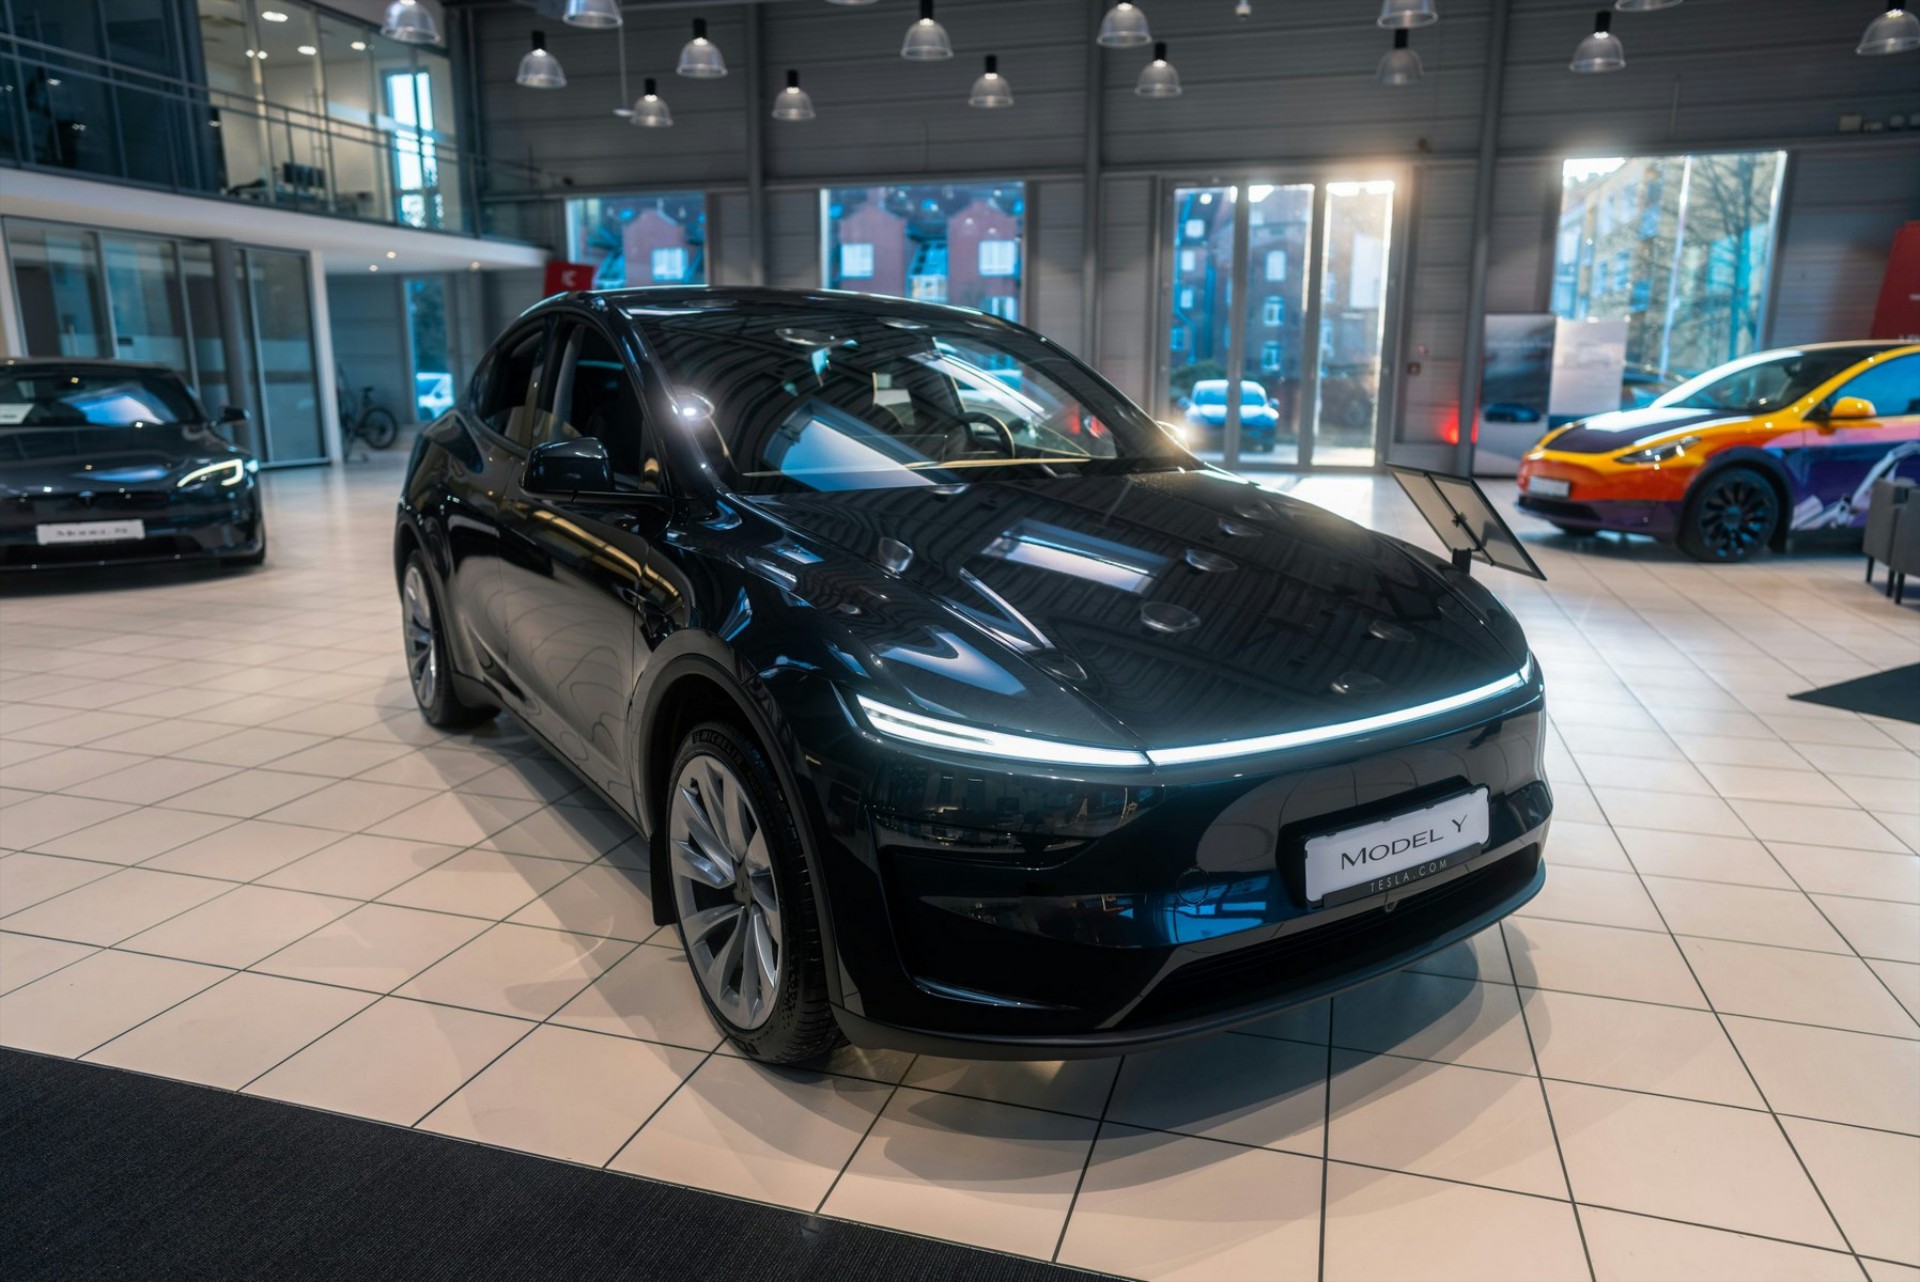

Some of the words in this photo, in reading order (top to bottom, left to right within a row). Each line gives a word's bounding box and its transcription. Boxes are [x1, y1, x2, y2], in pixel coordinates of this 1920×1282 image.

[701, 730, 744, 765] MICHELIN
[1341, 829, 1444, 870] MODEL
[1451, 814, 1468, 833] Y
[1370, 858, 1447, 892] TESLA.COM
